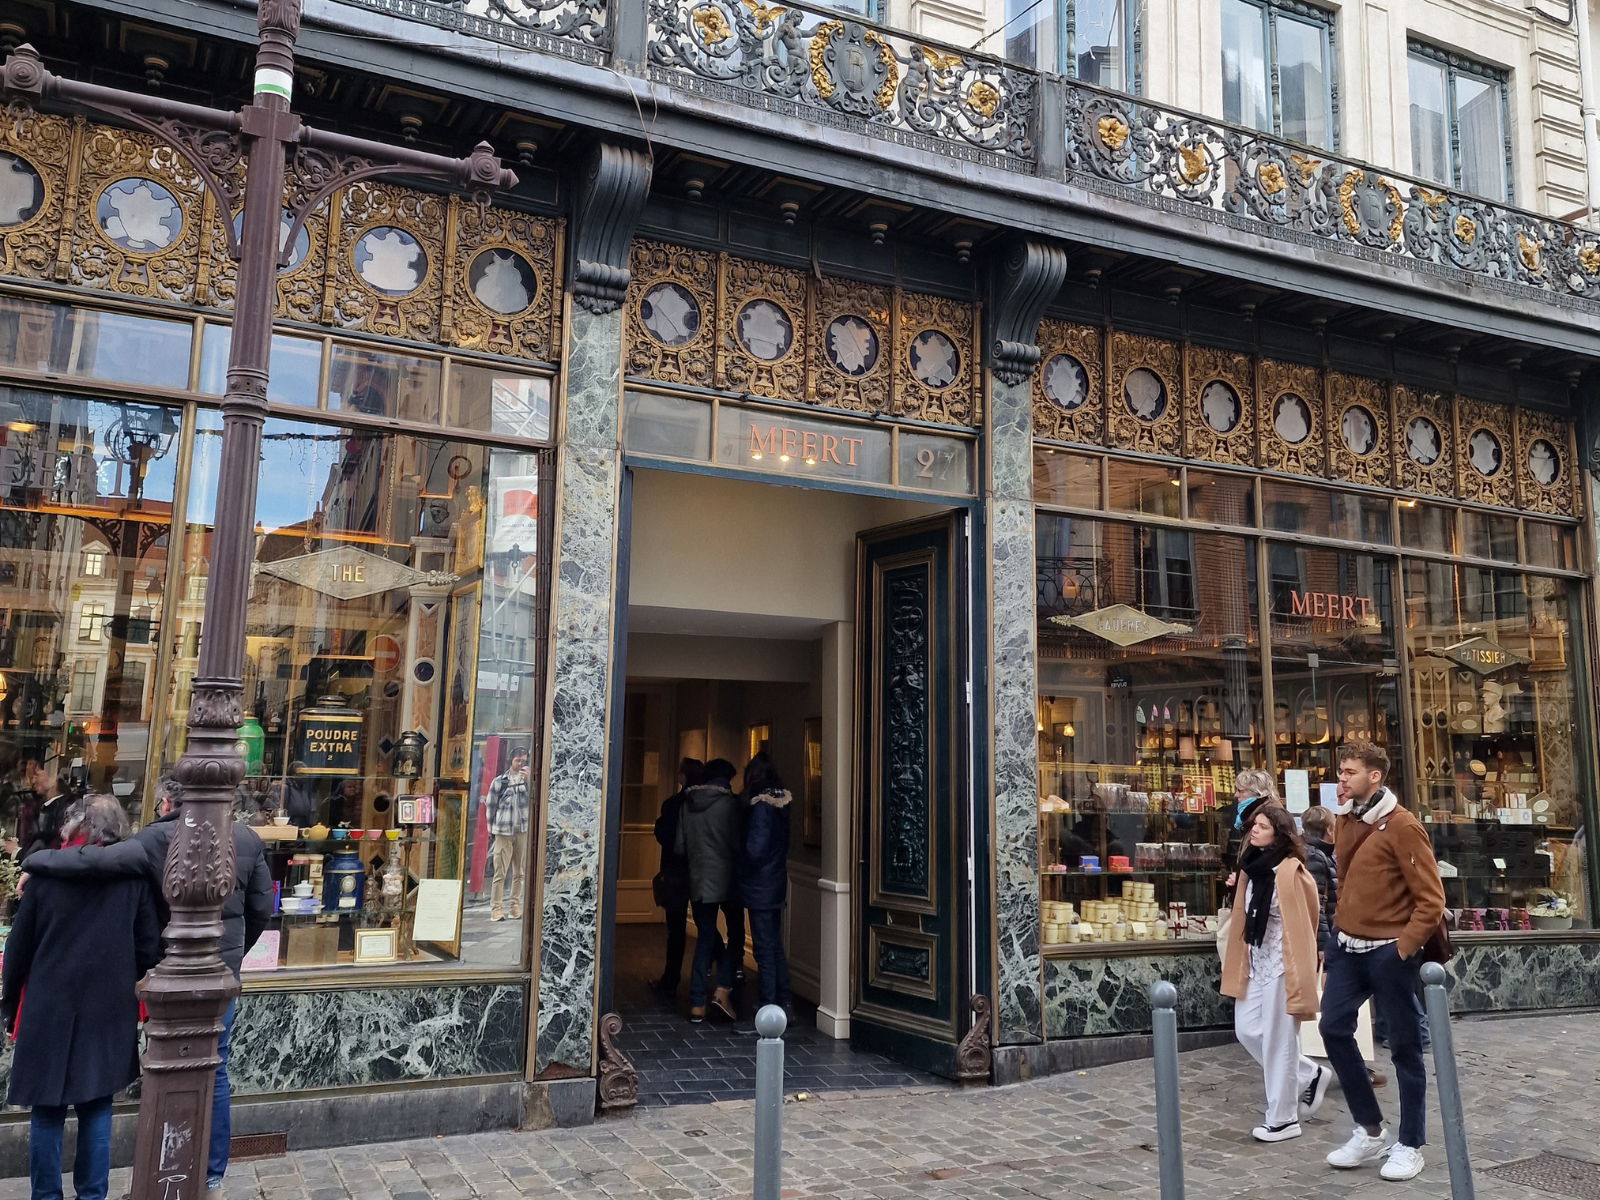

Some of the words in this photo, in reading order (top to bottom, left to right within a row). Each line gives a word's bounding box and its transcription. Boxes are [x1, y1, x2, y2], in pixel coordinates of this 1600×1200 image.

[748, 423, 864, 467] MEERT
[331, 556, 366, 583] THÉ
[1290, 589, 1371, 623] MEERT
[1095, 617, 1150, 635] GAUFRES
[306, 729, 358, 741] POUDRE
[309, 742, 353, 753] EXTRA
